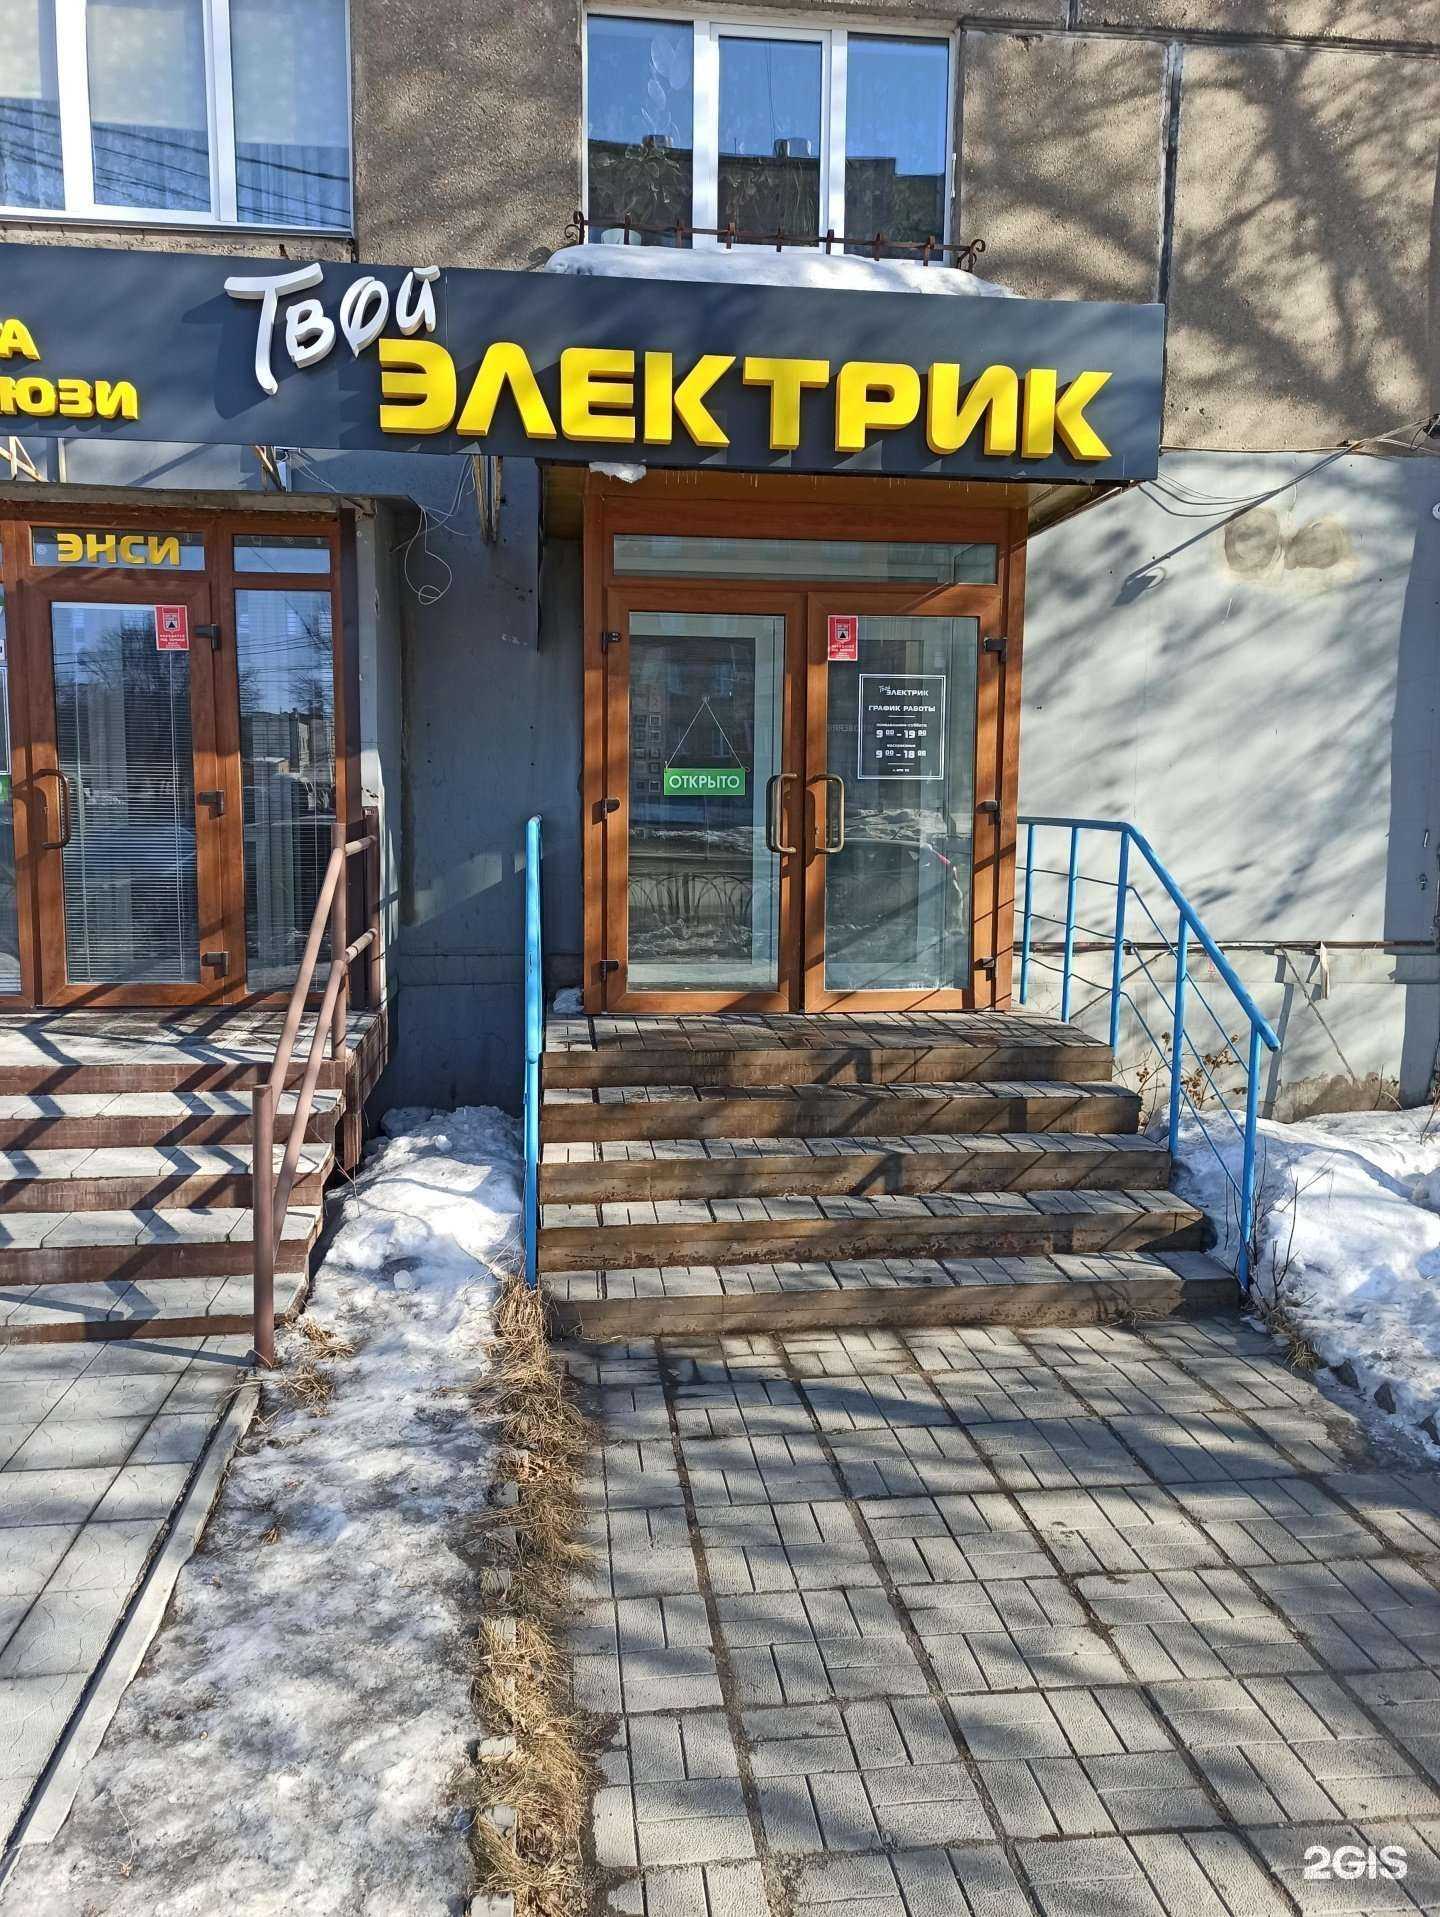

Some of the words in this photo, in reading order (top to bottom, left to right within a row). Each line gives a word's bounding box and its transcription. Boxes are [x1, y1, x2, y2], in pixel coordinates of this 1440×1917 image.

[0, 318, 41, 361] А
[224, 262, 441, 396] Твой
[0, 376, 139, 420] ЮЗИ
[378, 338, 1113, 461] ЭЛЕКТРИК
[56, 533, 180, 565] ЭНСИ
[904, 729, 916, 739] 19
[669, 775, 740, 789] ОТКРЫТО
